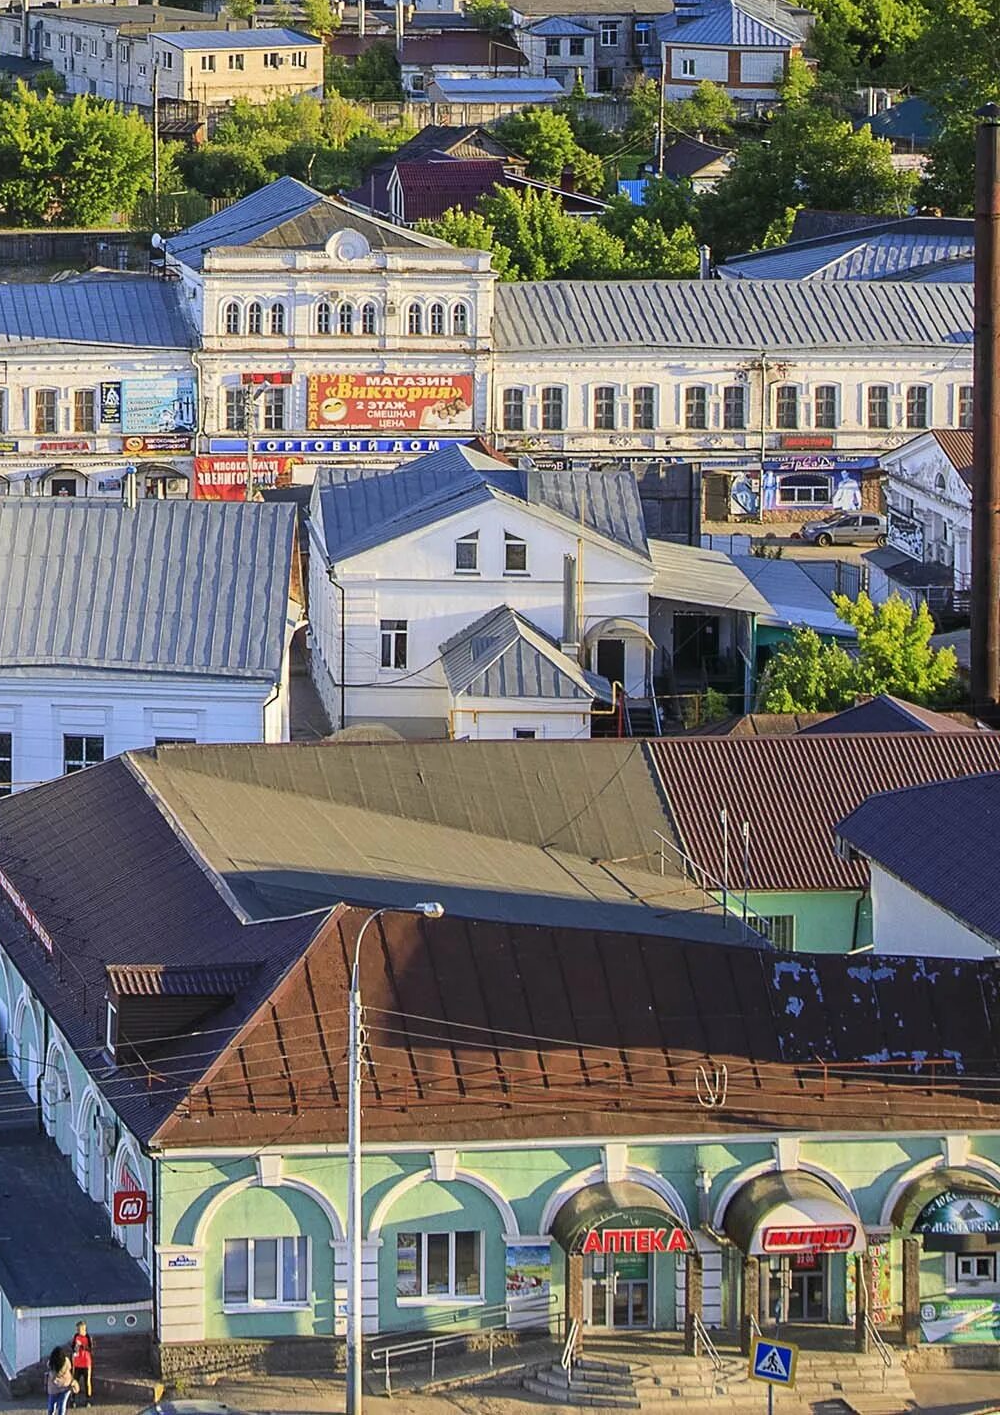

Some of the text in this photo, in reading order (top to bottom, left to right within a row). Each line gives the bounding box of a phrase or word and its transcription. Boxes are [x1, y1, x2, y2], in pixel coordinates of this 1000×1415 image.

[366, 376, 453, 386] МАГАЗИН
[325, 383, 463, 402] «Виктория»
[356, 401, 407, 410] 2 ЭТАЖ
[366, 410, 416, 419] СМЕШНАЯ
[379, 419, 406, 429] ЦЕНА
[39, 441, 89, 451] АПТЕКА
[251, 441, 440, 452] ТОРГОВЫЙ ДОМ
[213, 459, 279, 471] МЯСОКОБИНАТ
[582, 1227, 688, 1254] АПТЕКА
[767, 1229, 850, 1246] МАГНИТ
